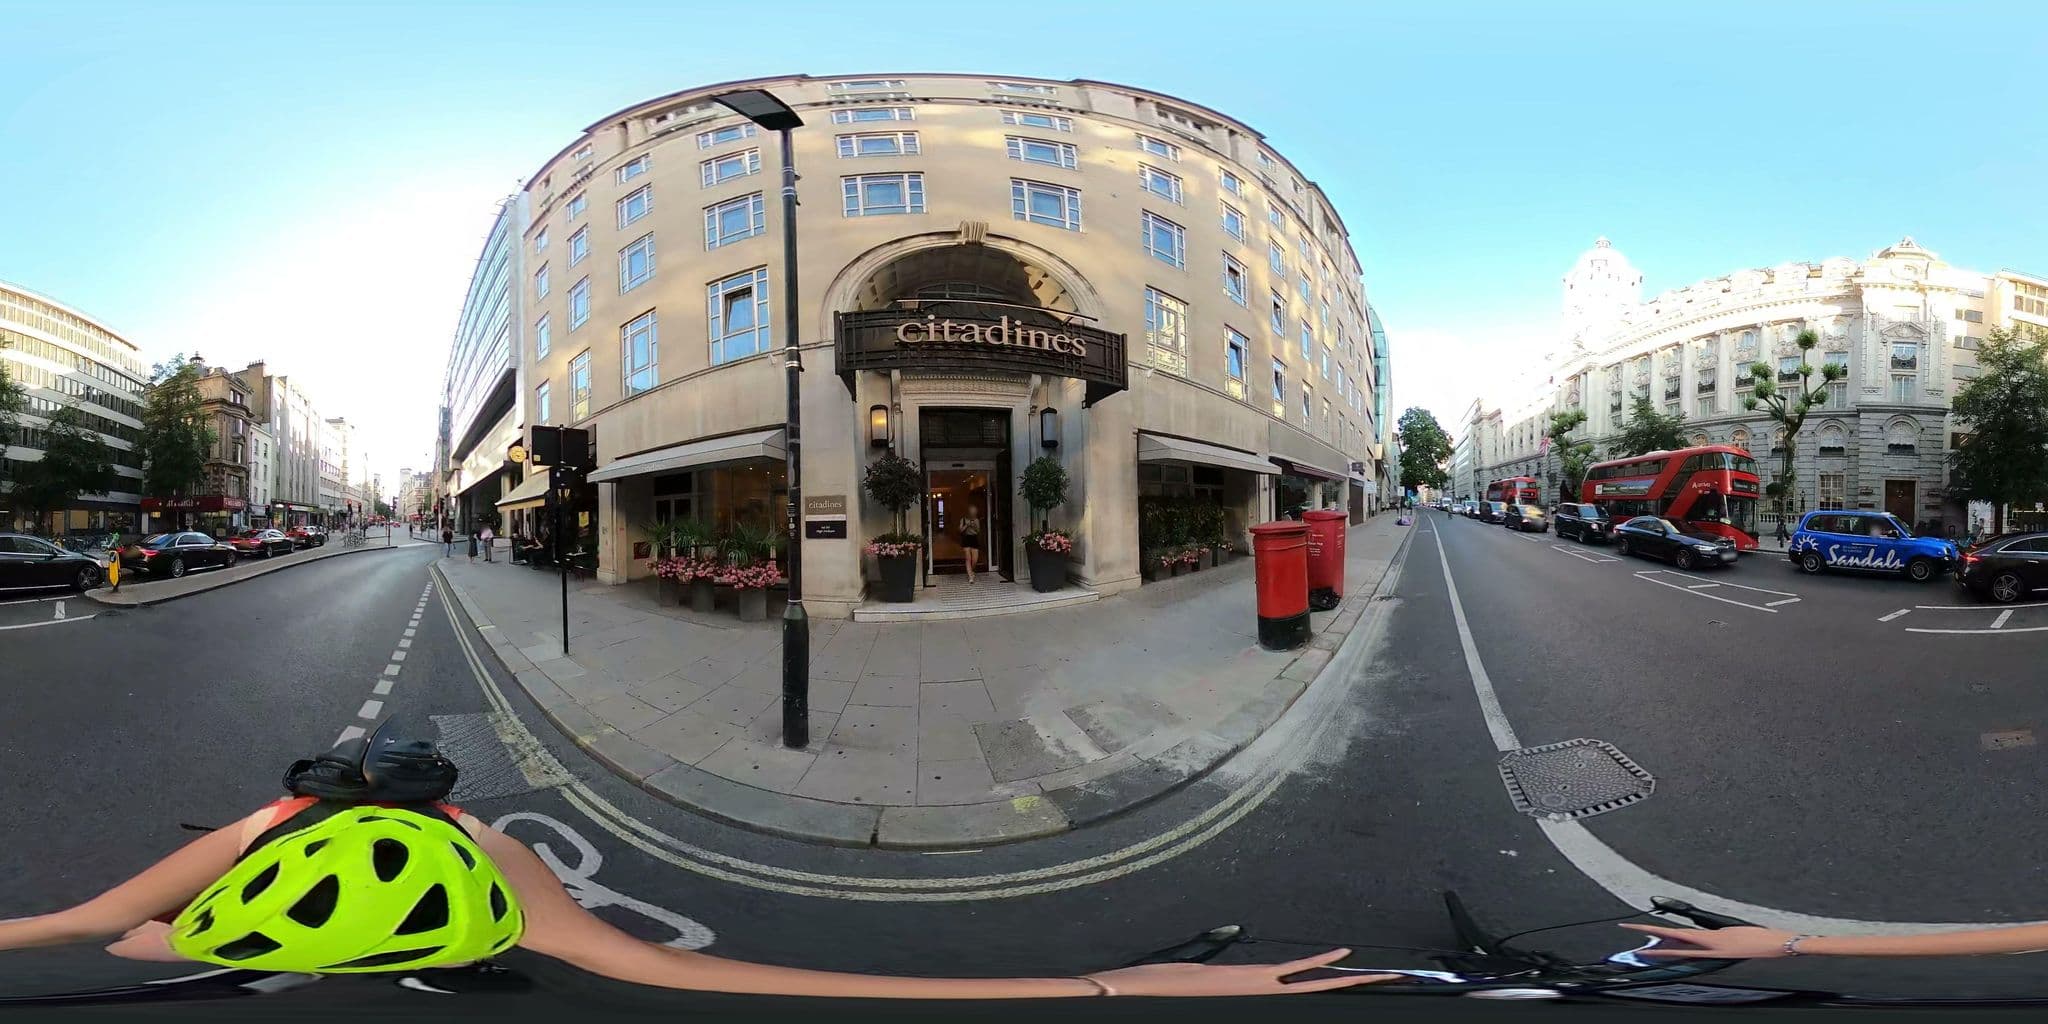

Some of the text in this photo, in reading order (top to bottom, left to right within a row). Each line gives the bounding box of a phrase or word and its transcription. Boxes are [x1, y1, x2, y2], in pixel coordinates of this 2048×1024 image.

[897, 314, 1086, 357] citadines
[808, 500, 842, 509] citadines
[1826, 544, 1904, 569] Sandals
